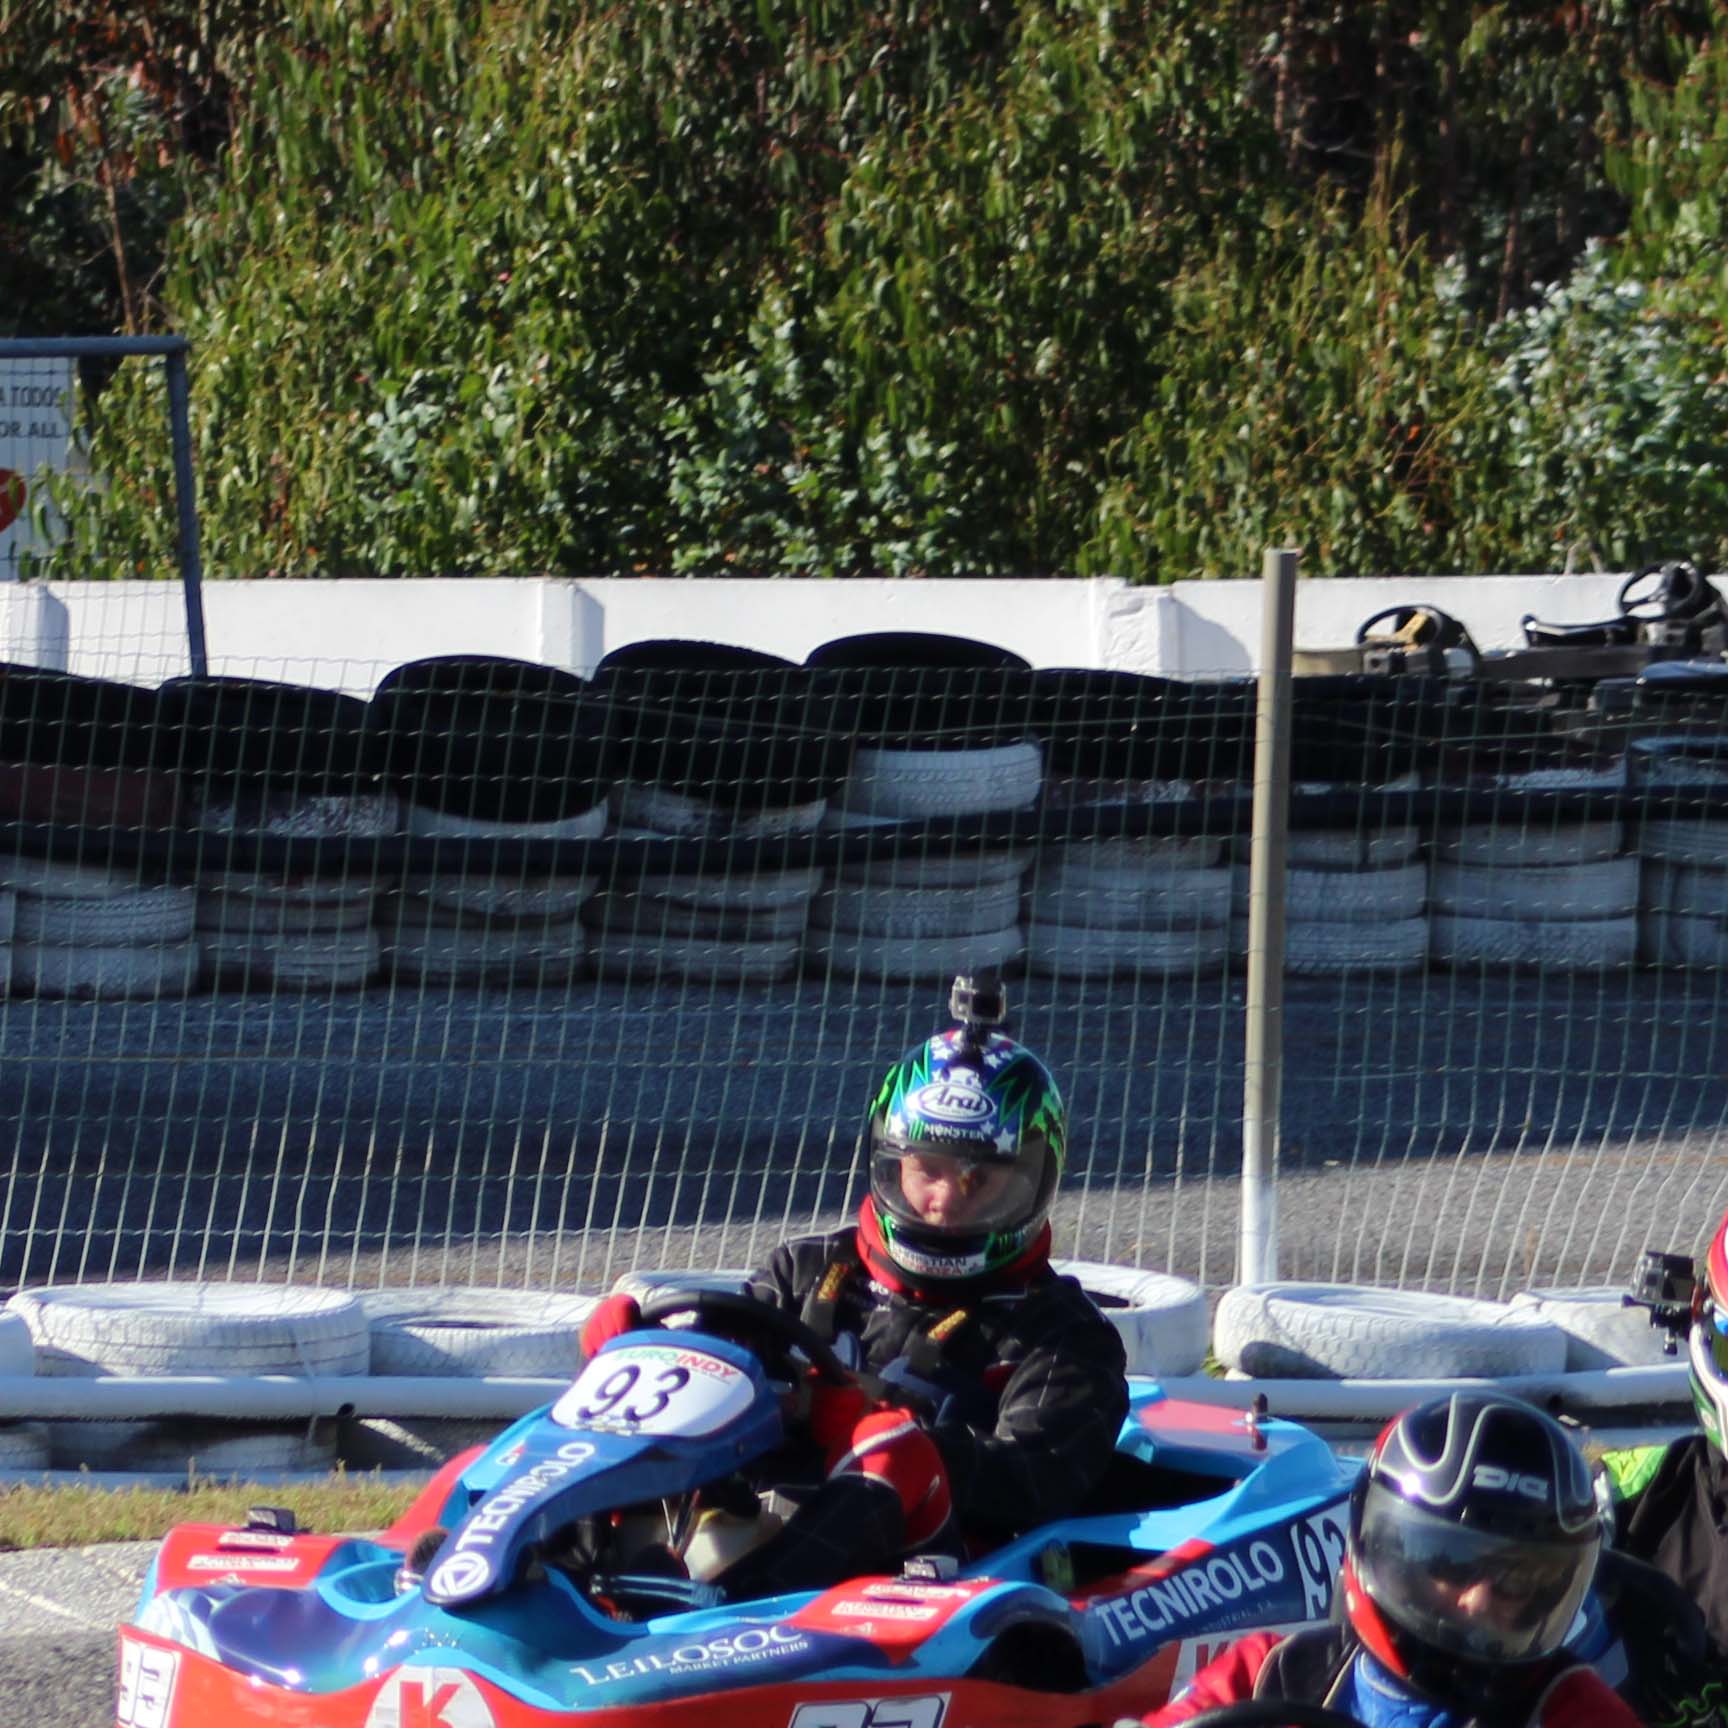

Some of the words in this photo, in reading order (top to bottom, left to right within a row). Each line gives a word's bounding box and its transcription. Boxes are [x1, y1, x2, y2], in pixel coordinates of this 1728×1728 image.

[28, 421, 62, 438] ALL
[577, 1364, 690, 1422] 93
[1095, 1541, 1284, 1646] TECNIROLO
